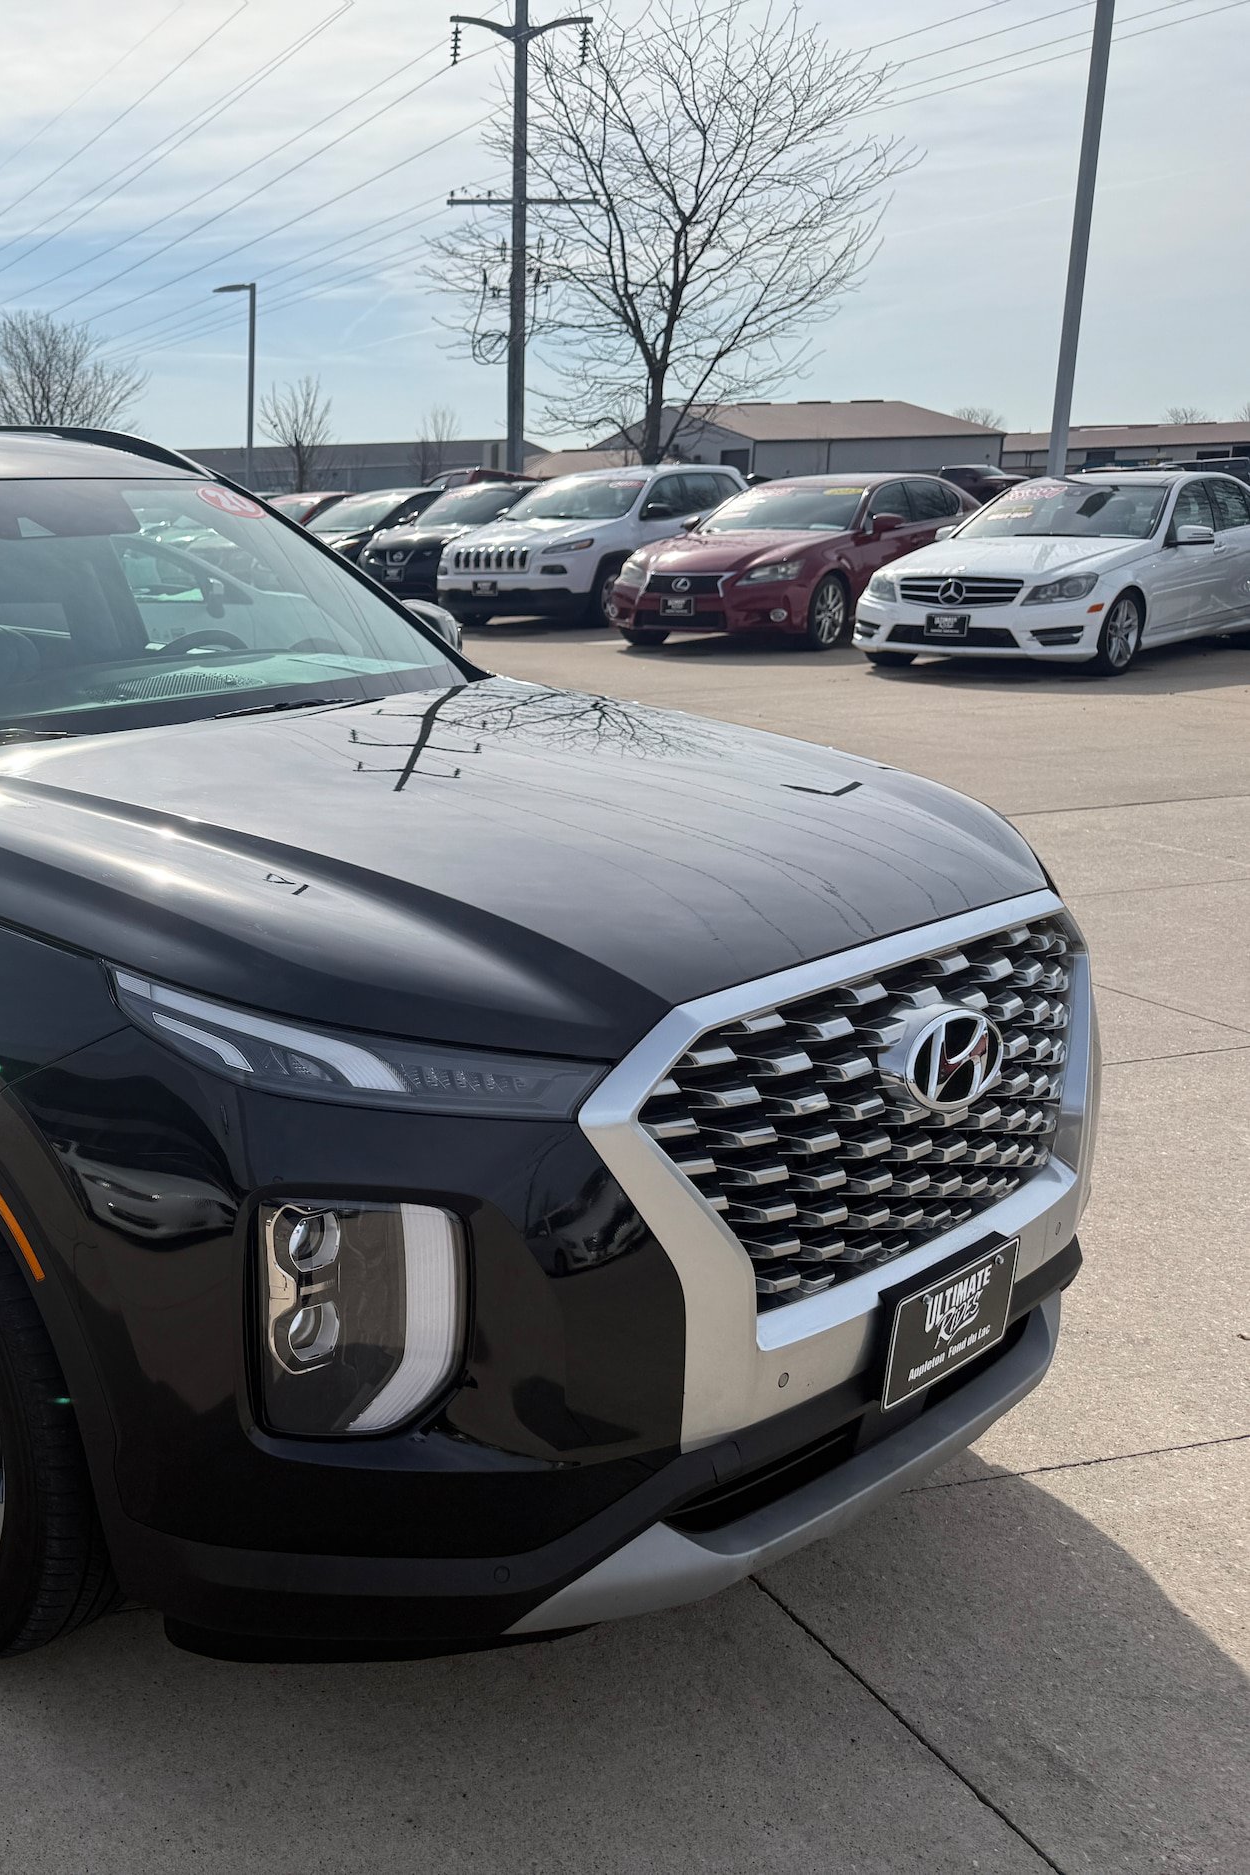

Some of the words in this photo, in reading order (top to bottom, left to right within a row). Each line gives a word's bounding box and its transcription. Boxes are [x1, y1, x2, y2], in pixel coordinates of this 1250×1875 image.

[204, 489, 256, 513] 20
[924, 1264, 993, 1333] ULTIMATE
[934, 1289, 983, 1350] RIDES
[908, 1352, 946, 1382] Appleton
[947, 1341, 967, 1359] Fond
[966, 1333, 979, 1347] du
[978, 1324, 991, 1342] Lac
